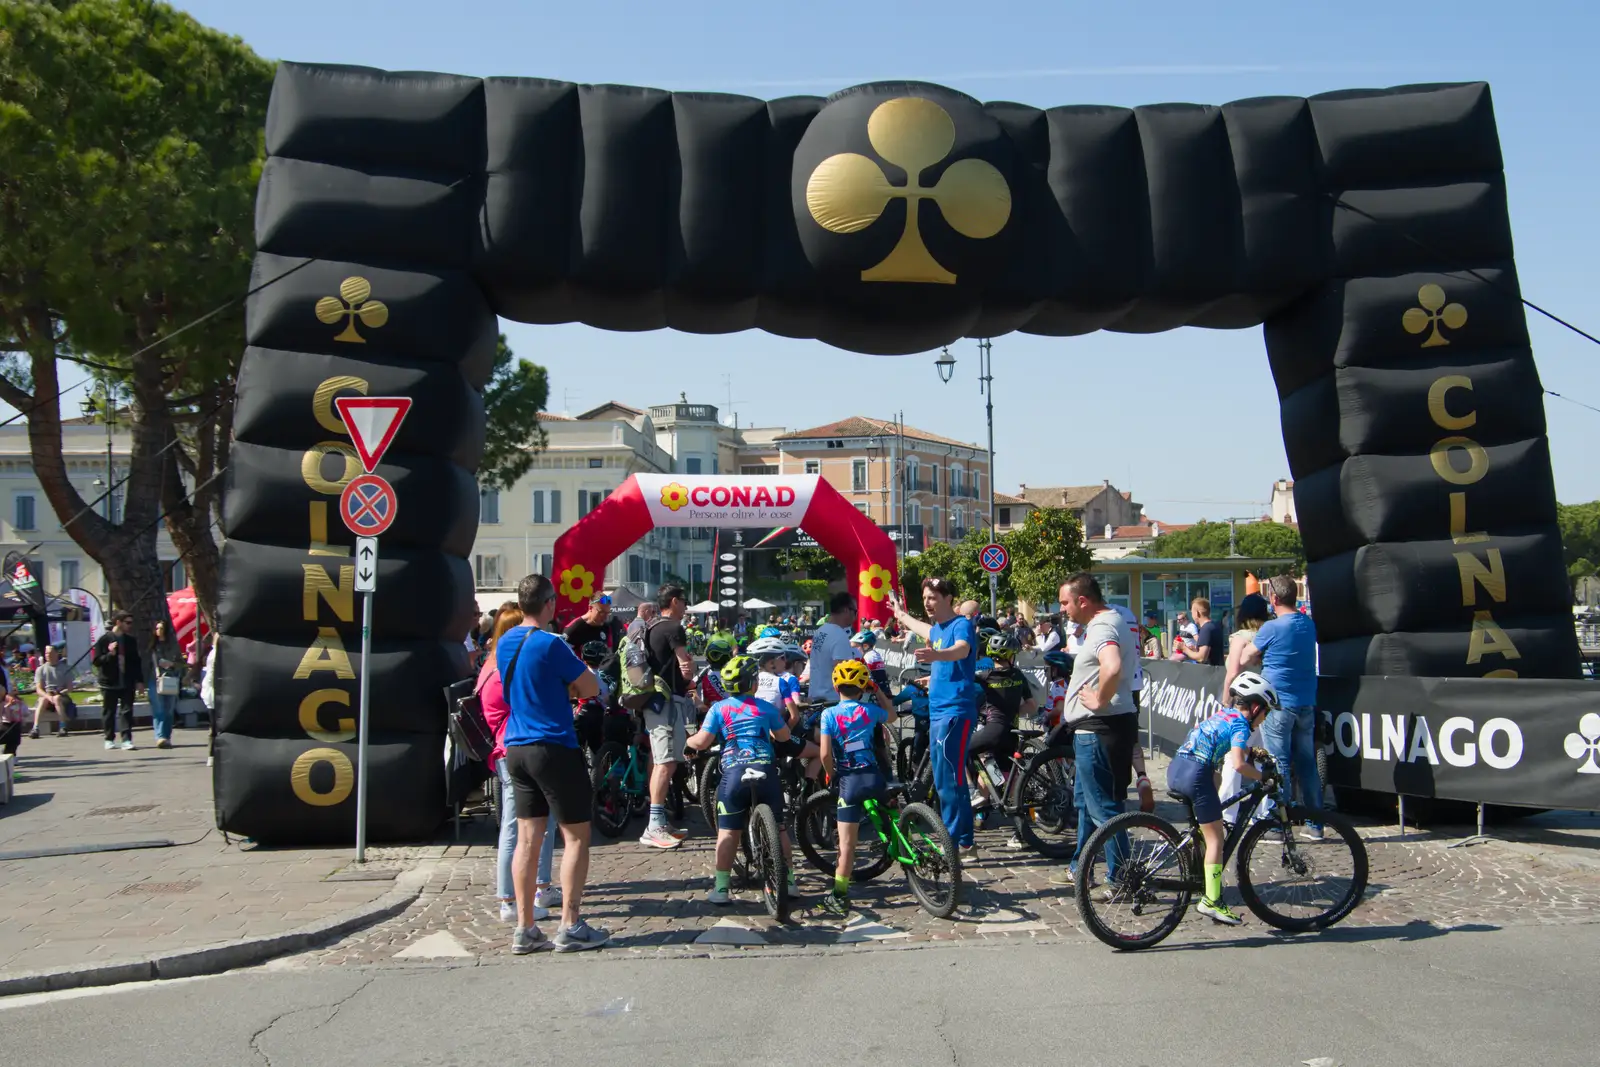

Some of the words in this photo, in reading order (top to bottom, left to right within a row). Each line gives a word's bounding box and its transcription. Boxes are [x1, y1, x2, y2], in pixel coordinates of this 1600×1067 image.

[689, 509, 728, 519] Persone
[731, 509, 755, 519] oltre
[758, 509, 767, 519] le
[770, 511, 792, 519] cose
[691, 486, 796, 507] CONAD
[1427, 375, 1521, 678] COLNA
[290, 376, 369, 806] COLNAGO
